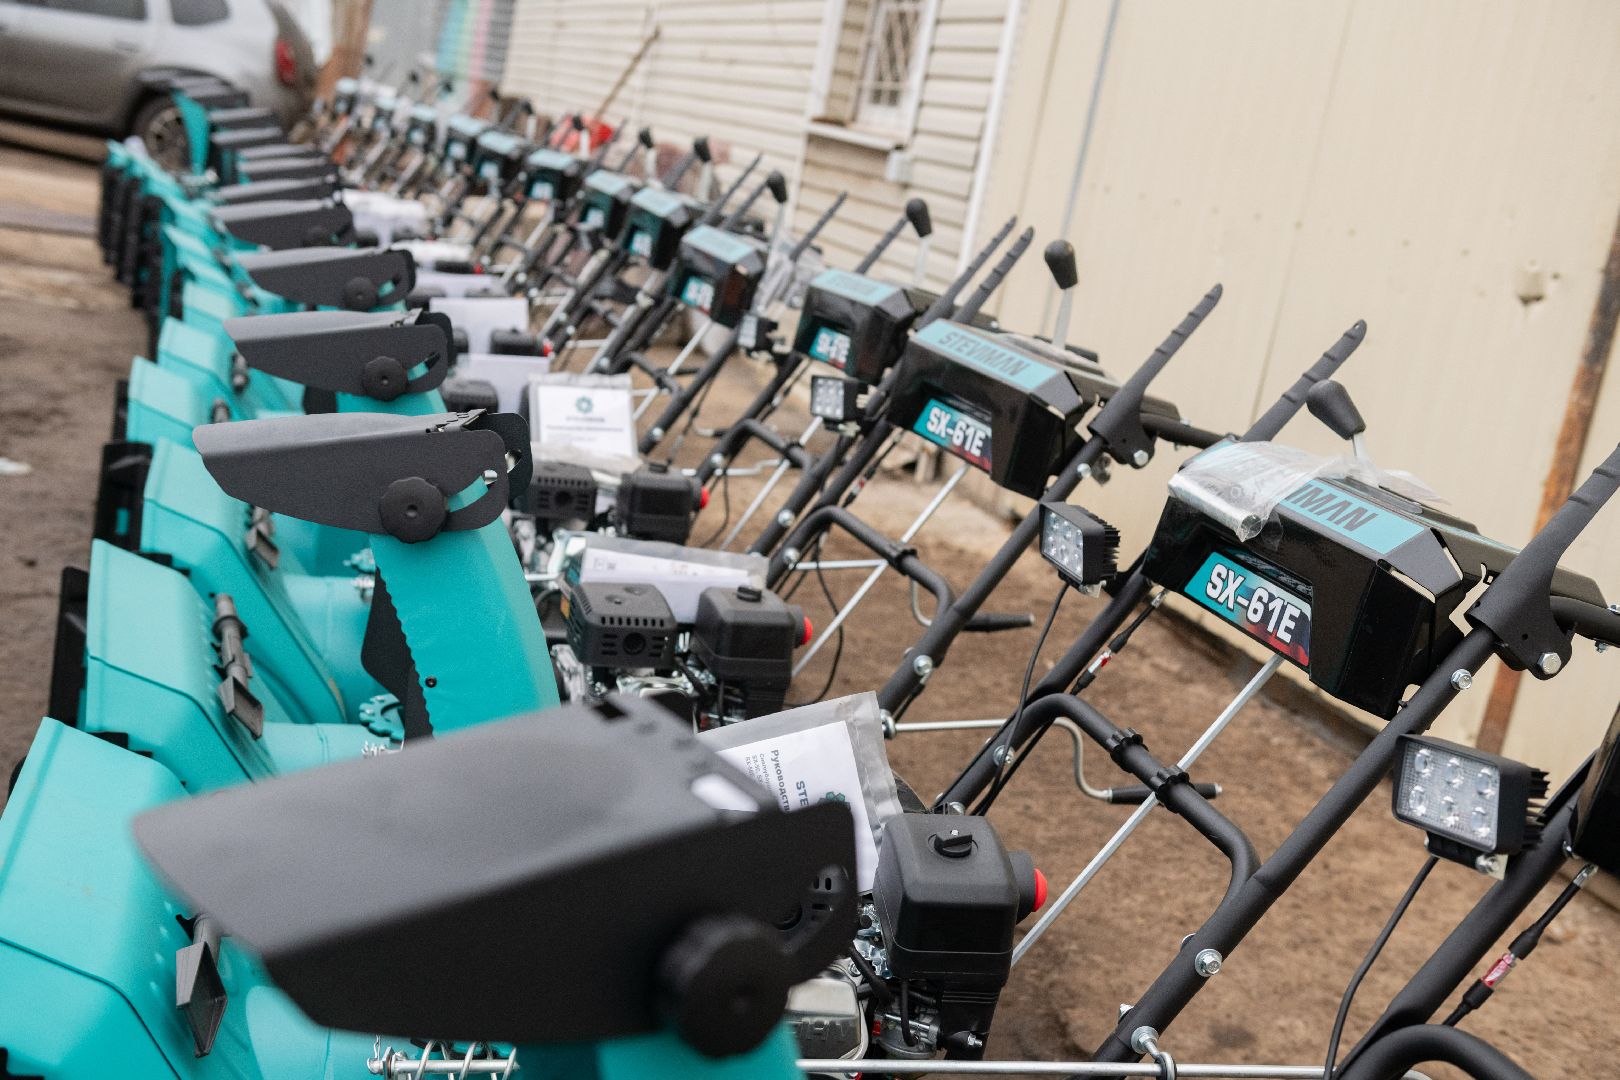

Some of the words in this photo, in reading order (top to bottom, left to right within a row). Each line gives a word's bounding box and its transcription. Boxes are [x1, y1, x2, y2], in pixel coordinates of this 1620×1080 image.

[938, 331, 1031, 376] STEVIMAN
[926, 407, 986, 457] SX-61E
[1285, 484, 1379, 531] IMAN
[1206, 563, 1302, 644] SX-61E
[770, 749, 791, 811] Руководств
[796, 780, 810, 807] STE
